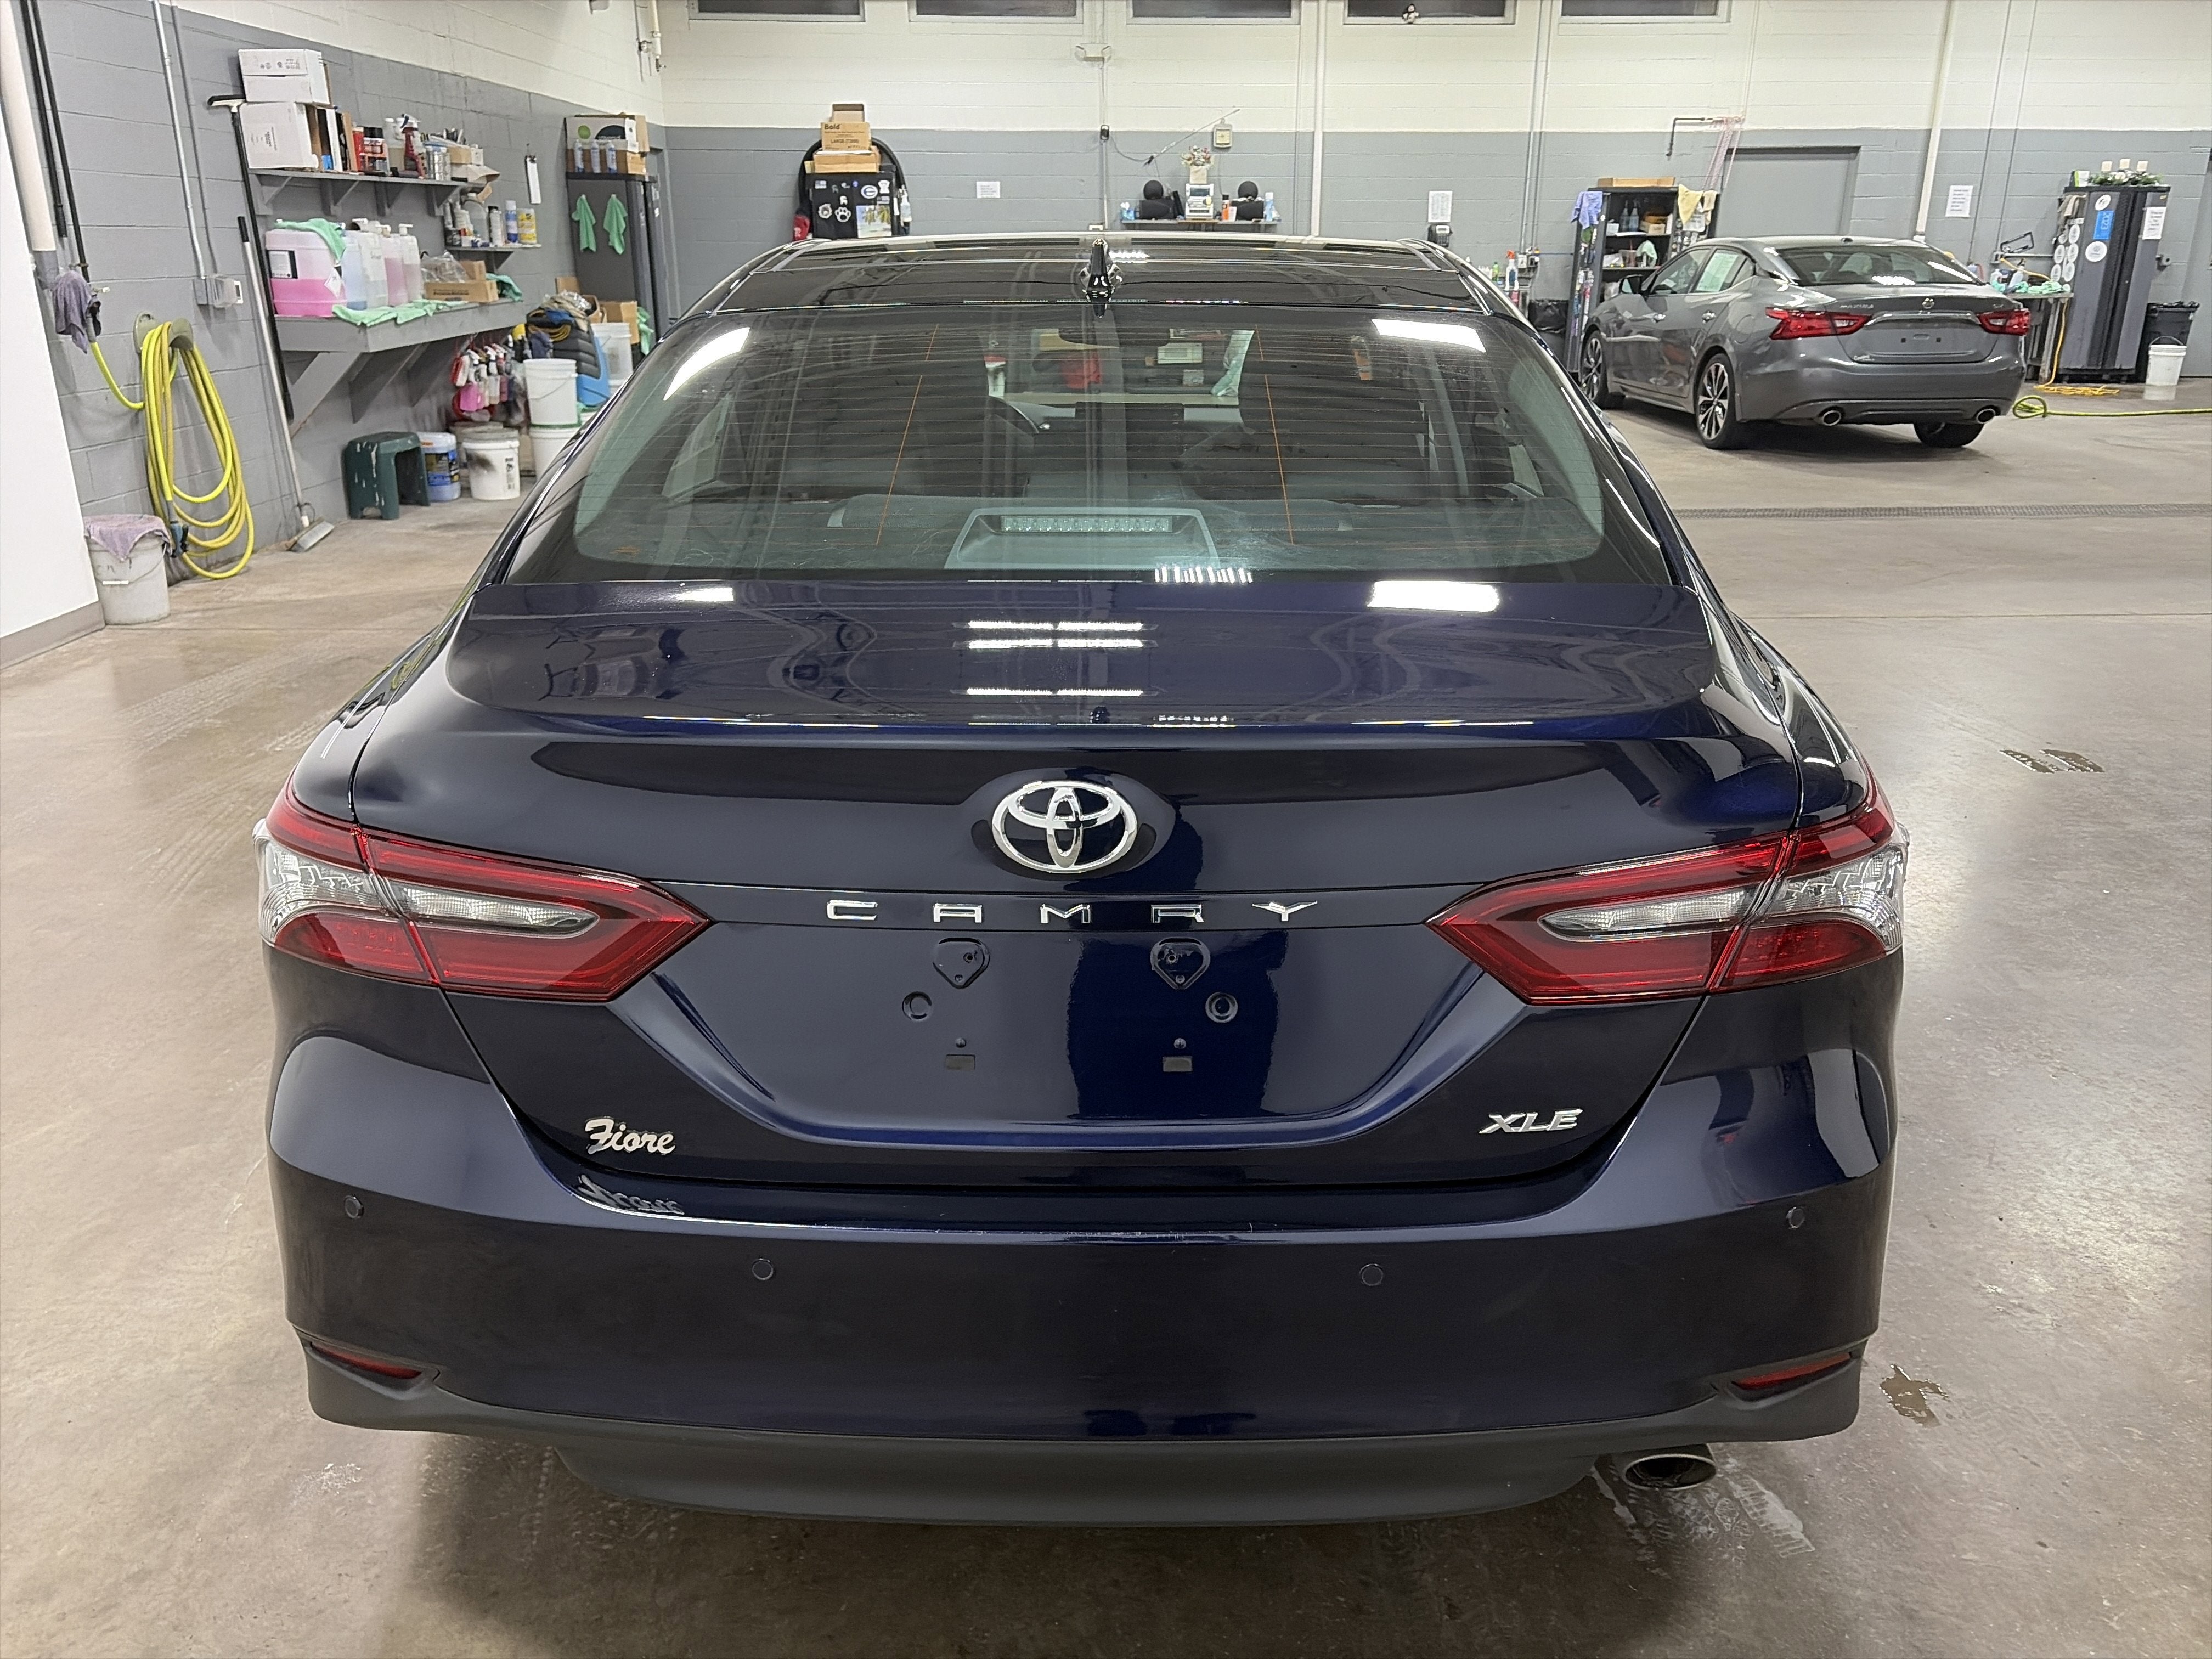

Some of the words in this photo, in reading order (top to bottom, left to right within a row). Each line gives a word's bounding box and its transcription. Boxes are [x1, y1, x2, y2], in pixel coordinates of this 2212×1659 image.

[826, 899, 1318, 924] CAMRY
[1479, 1108, 1583, 1134] XLE
[585, 1118, 676, 1155] Fiore
